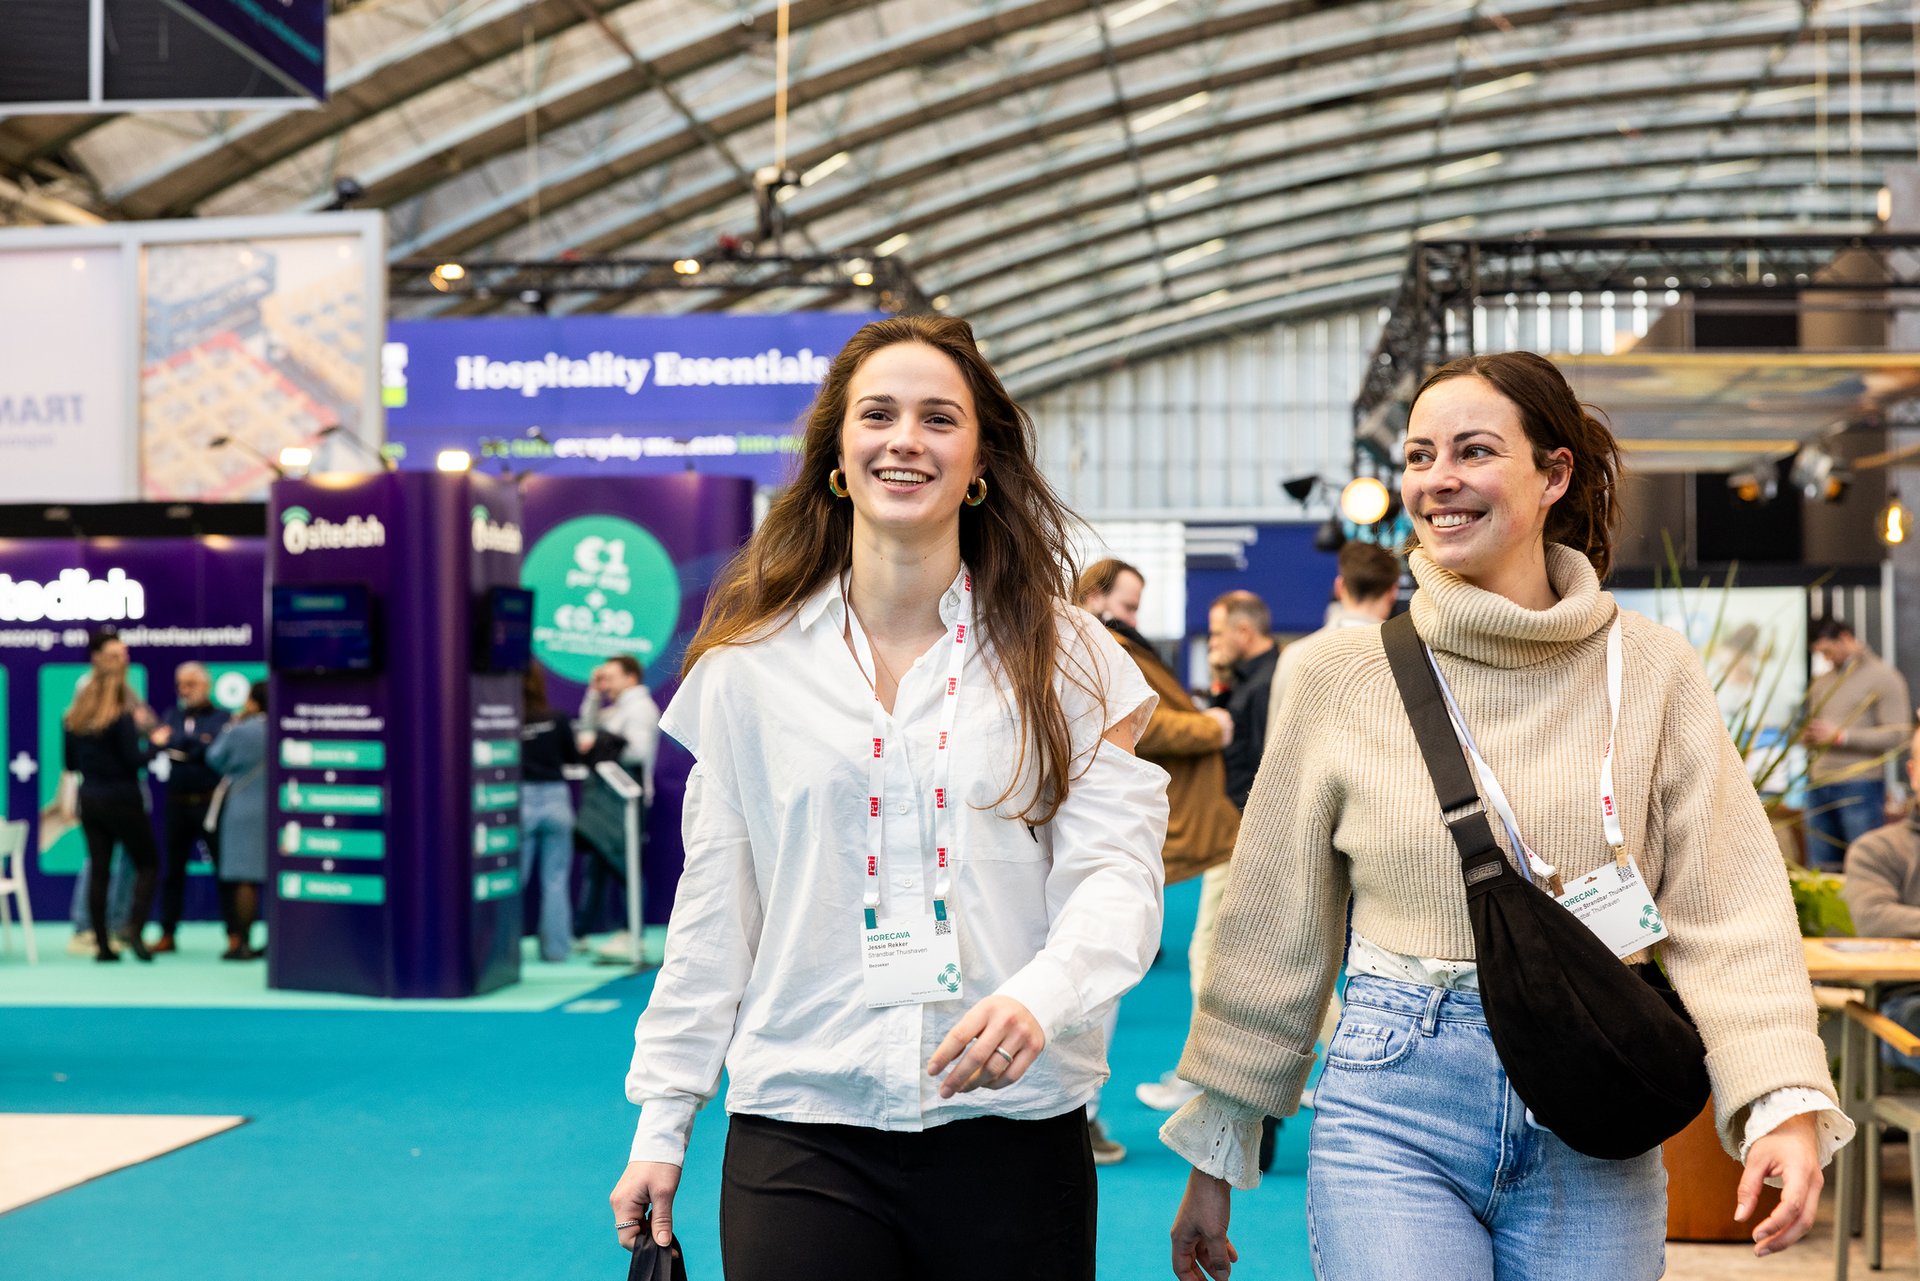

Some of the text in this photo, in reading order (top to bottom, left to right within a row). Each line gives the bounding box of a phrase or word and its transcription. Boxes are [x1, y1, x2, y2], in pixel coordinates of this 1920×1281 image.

[456, 350, 651, 397] Hospitality
[654, 347, 829, 387] Essentials
[956, 624, 965, 643] rai
[948, 677, 957, 695] rai
[873, 738, 882, 758] rai
[869, 796, 879, 817] rai
[935, 788, 944, 808] rai
[867, 855, 876, 876] rai
[937, 847, 946, 868] rai
[1608, 880, 1638, 897] Thuishaven
[867, 931, 911, 942] HORECAVA
[867, 941, 908, 951] Jessie Rekker
[868, 947, 928, 959] Strandbar Thuishaven
